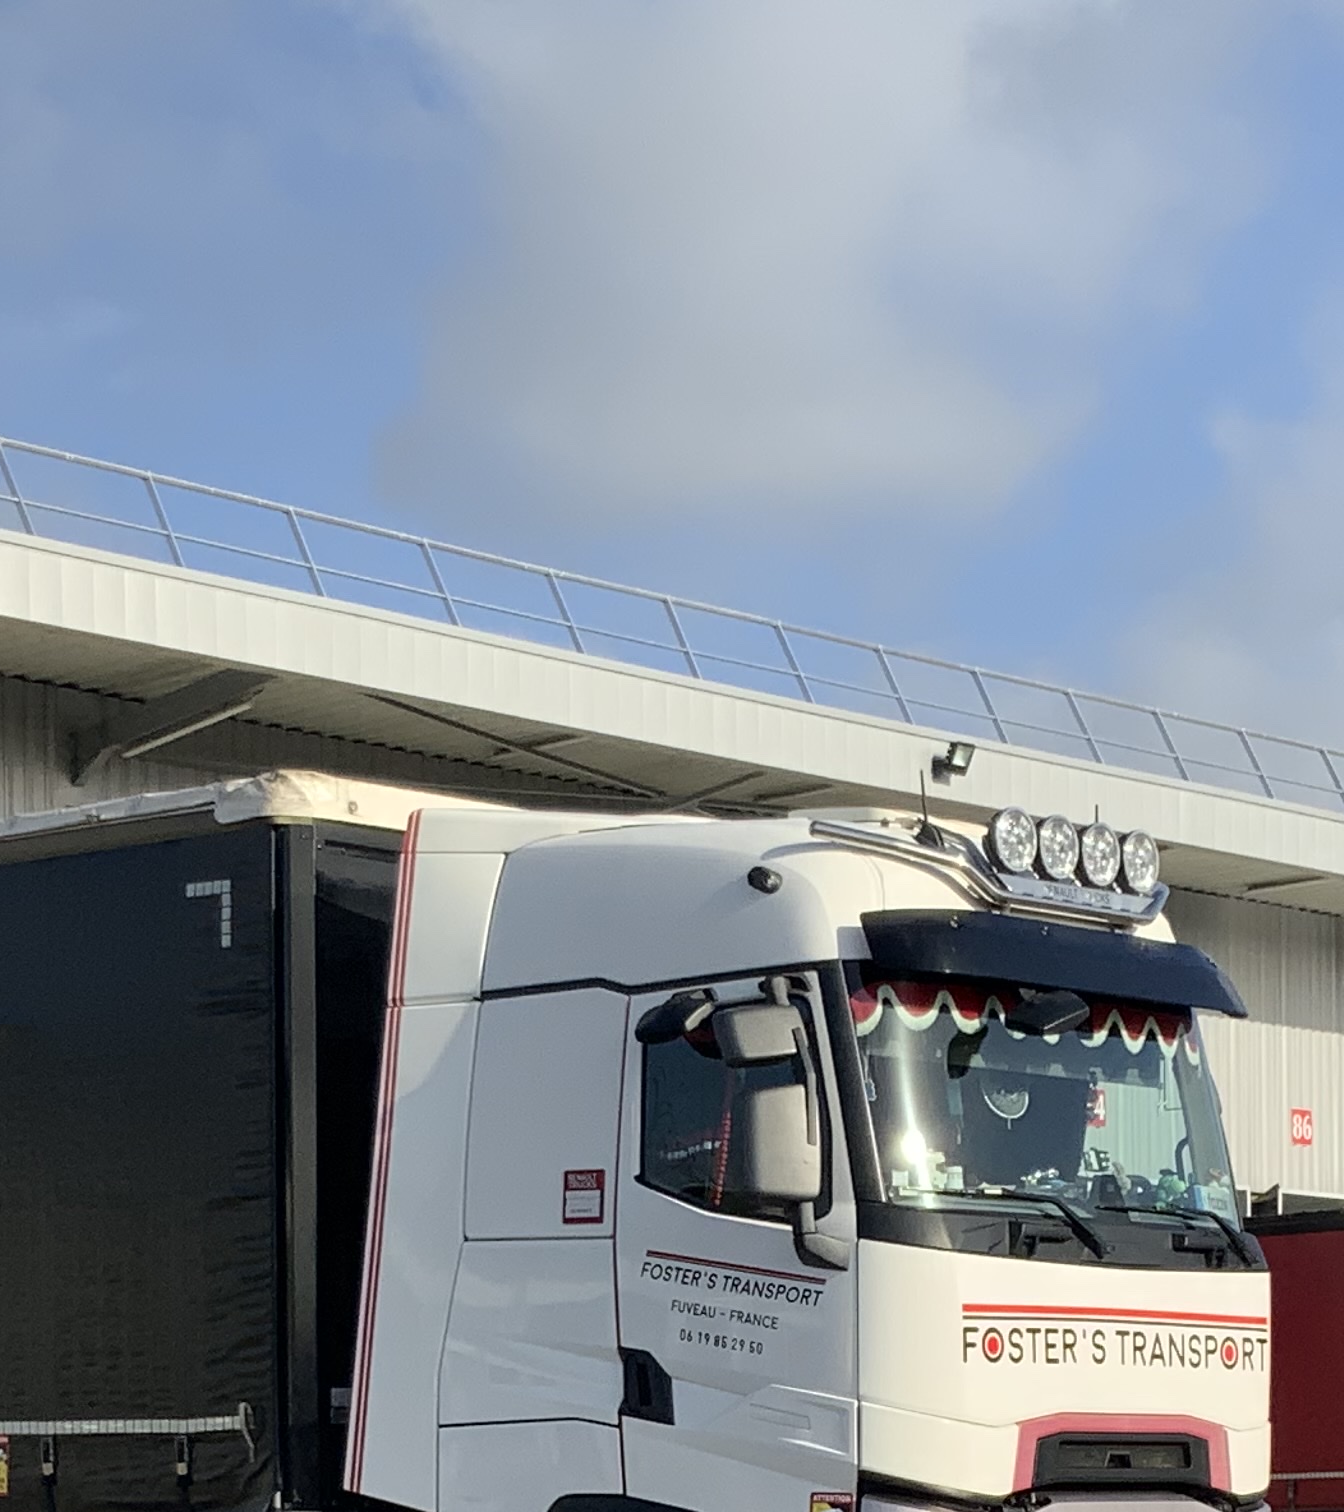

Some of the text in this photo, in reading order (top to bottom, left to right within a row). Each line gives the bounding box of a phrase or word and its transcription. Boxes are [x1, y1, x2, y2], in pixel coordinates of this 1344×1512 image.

[1292, 1114, 1312, 1140] 86
[641, 1262, 823, 1307] FOSTER'S TRANSPORT
[671, 1299, 716, 1319] FUVEAU
[729, 1309, 779, 1330] FRANCE
[680, 1328, 693, 1342] 06
[698, 1331, 710, 1345] 19
[731, 1338, 745, 1352] 29
[962, 1326, 1268, 1372] FOSTER'S TRANSPORT
